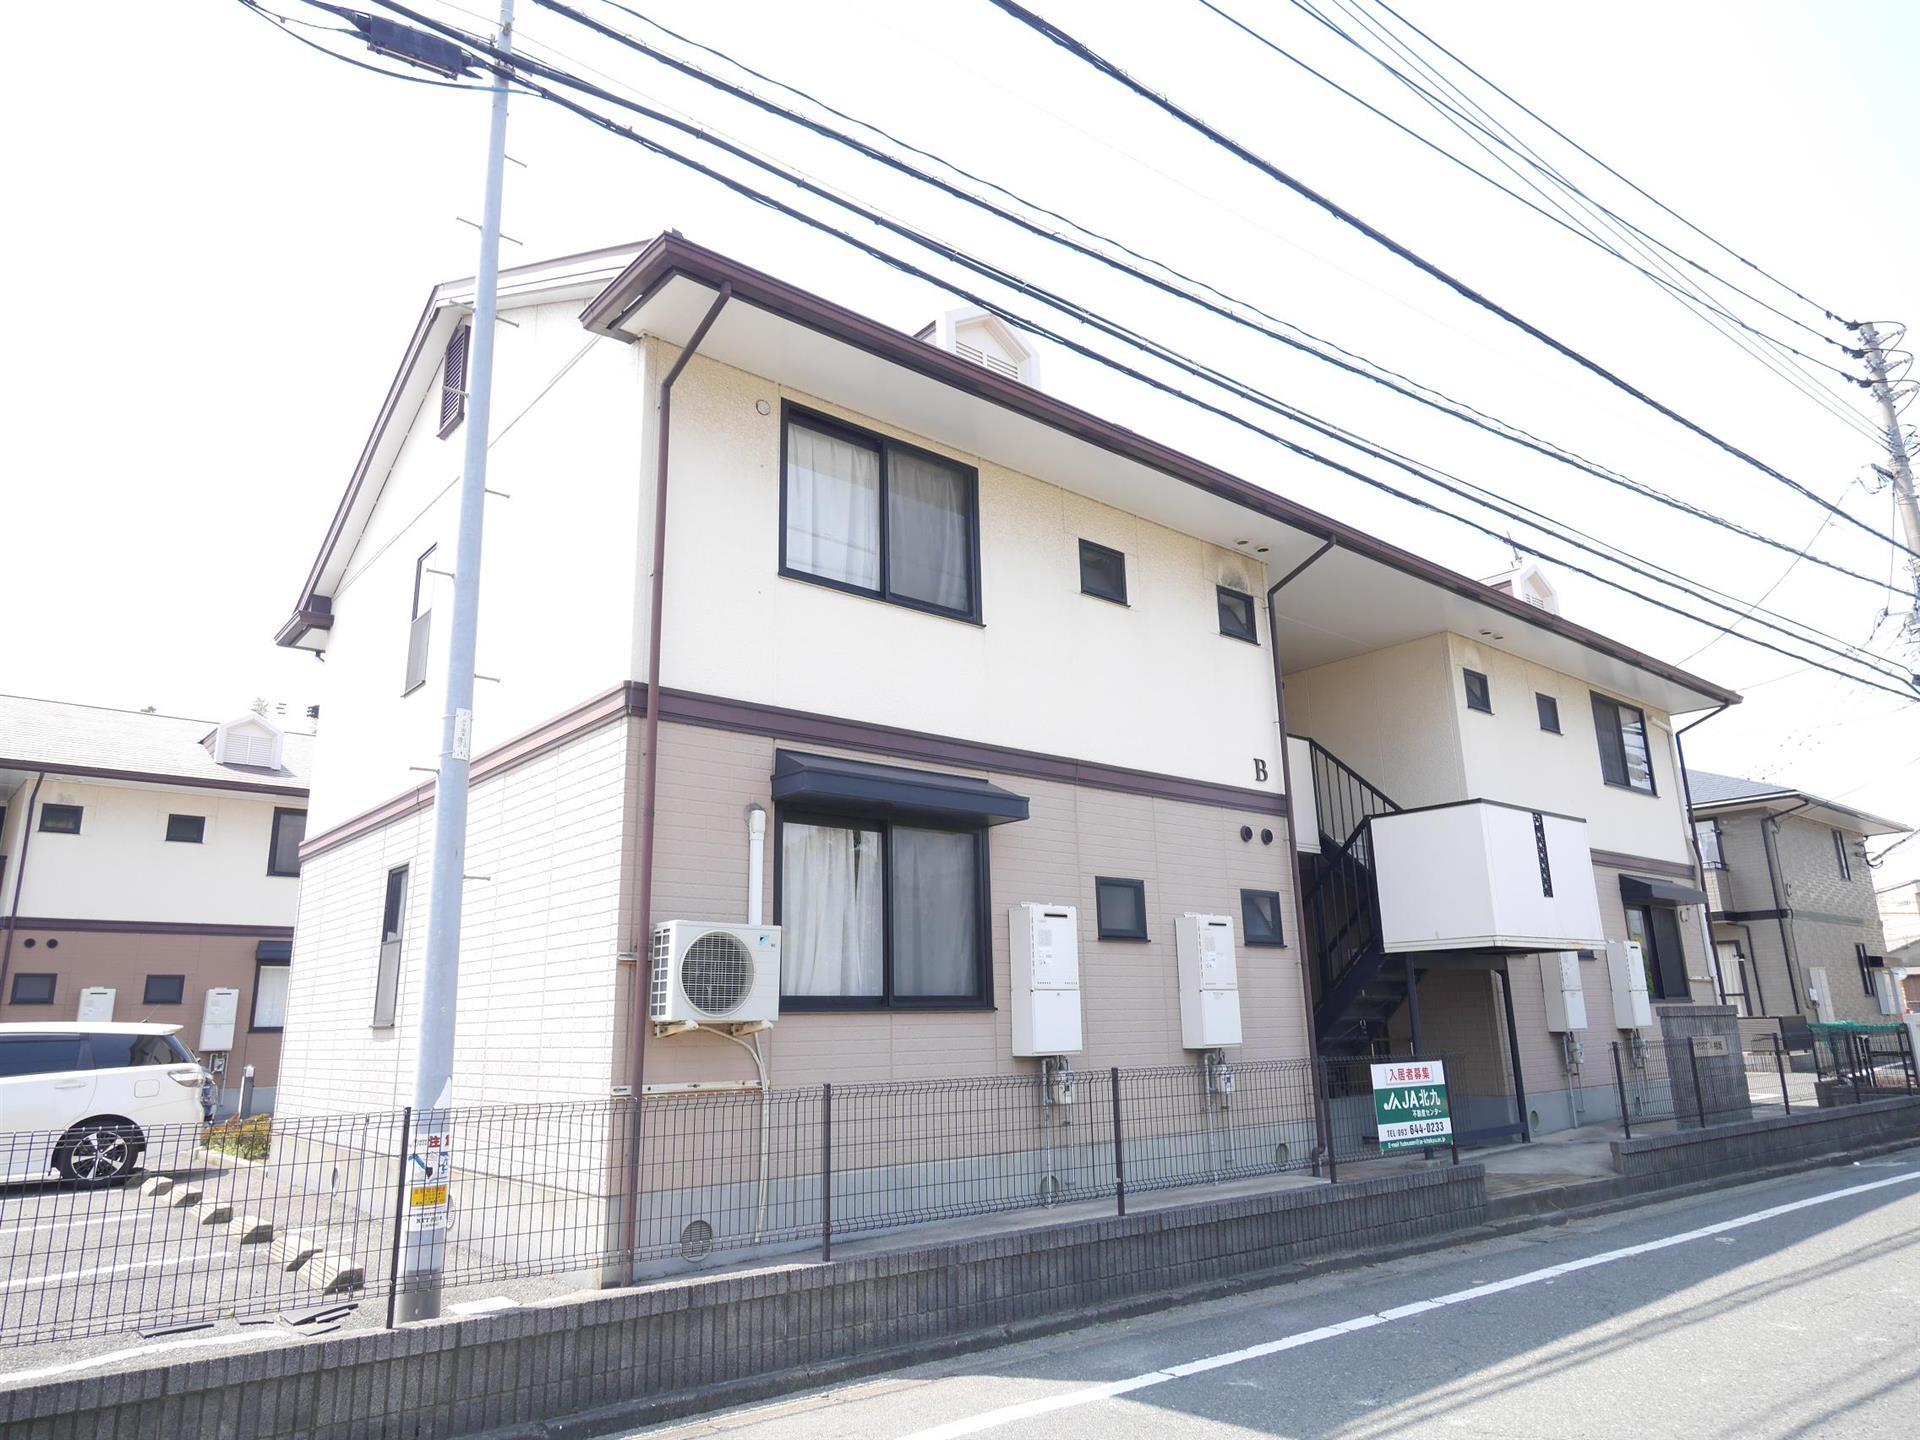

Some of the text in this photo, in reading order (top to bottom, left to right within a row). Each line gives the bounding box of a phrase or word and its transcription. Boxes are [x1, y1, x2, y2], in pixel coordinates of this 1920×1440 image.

[1253, 758, 1268, 782] B
[1390, 1067, 1430, 1081] 入居者募集
[1409, 1122, 1444, 1135] 644-0233
